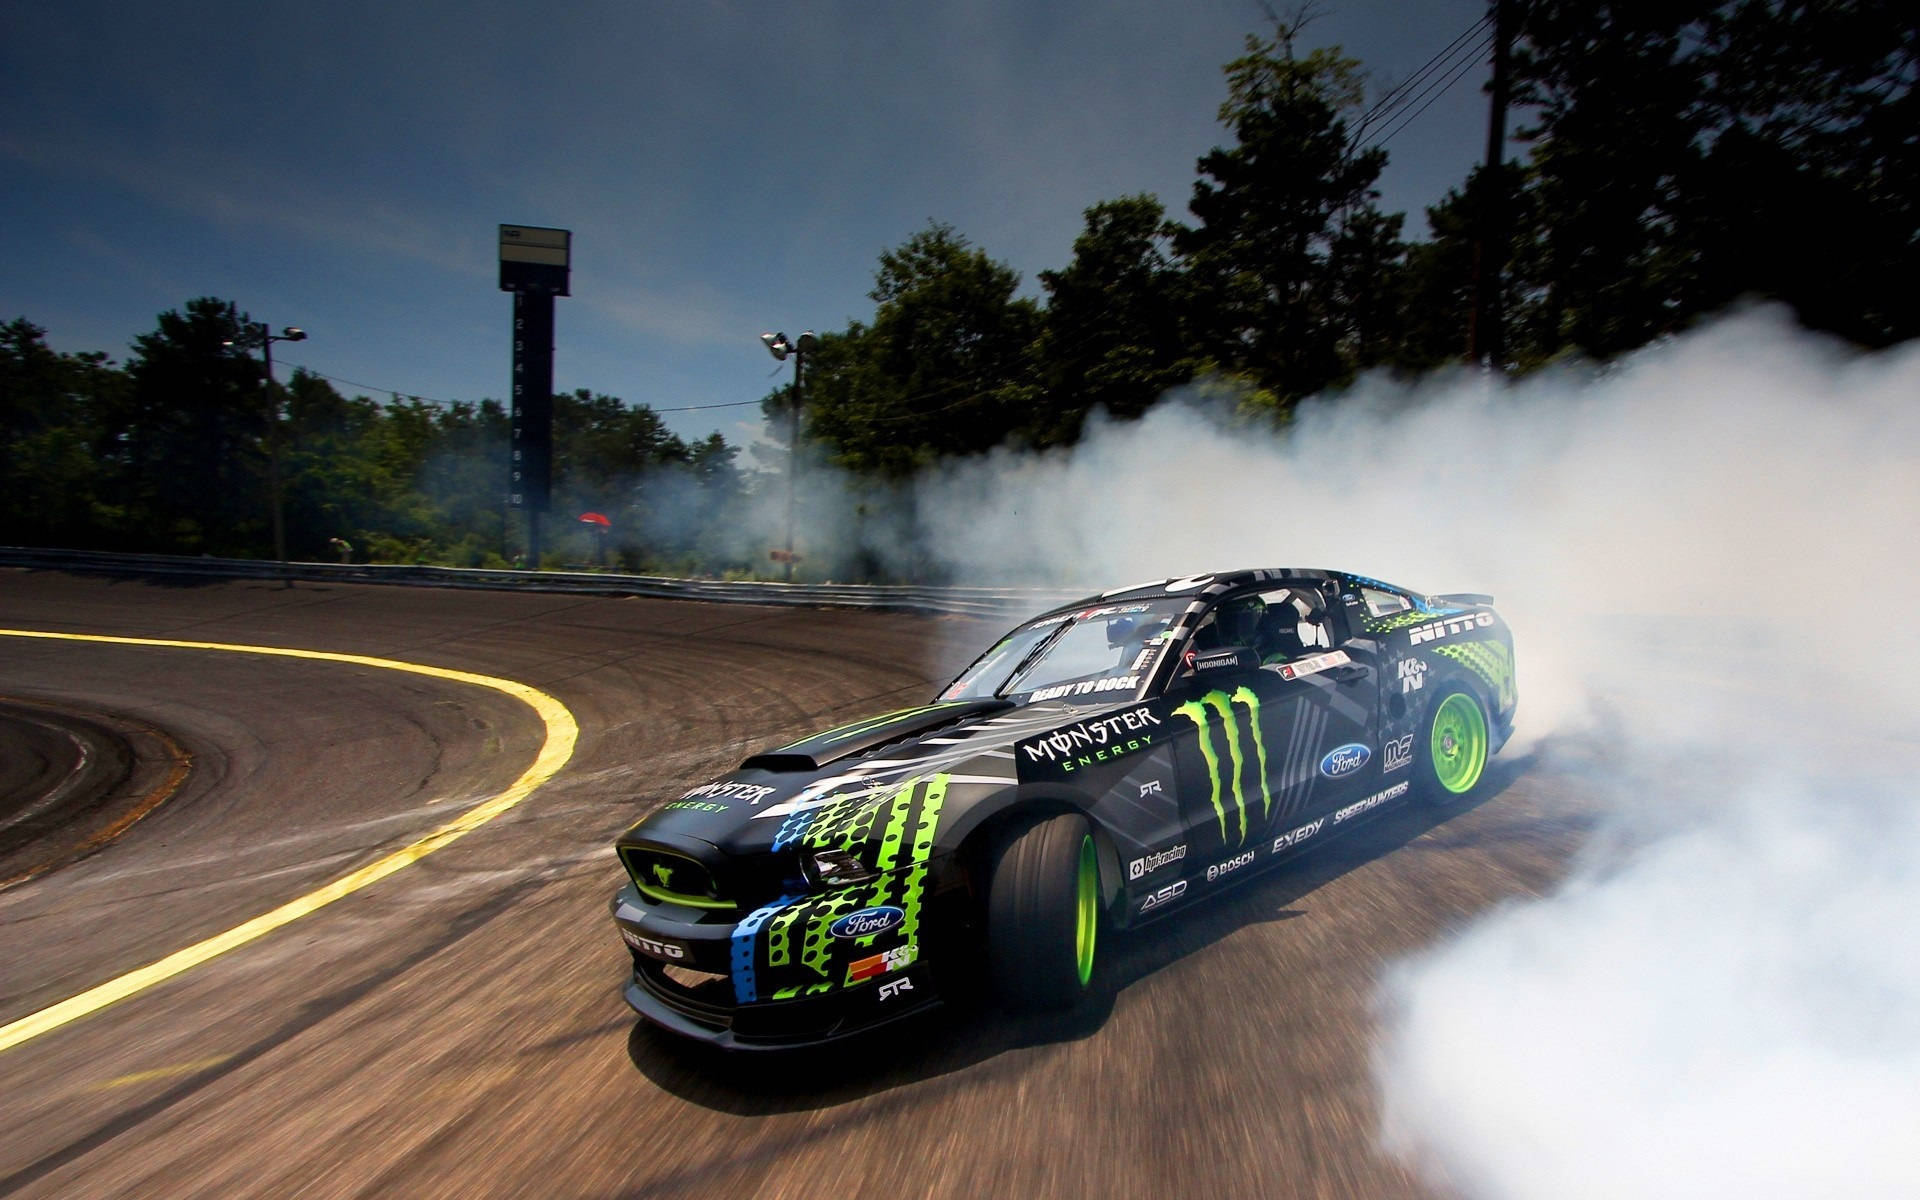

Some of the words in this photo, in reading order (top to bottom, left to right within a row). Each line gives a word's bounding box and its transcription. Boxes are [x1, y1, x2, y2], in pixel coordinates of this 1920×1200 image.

[515, 319, 524, 330] 2
[514, 429, 524, 440] 7
[514, 471, 523, 482] 9
[1408, 611, 1495, 646] NITTO
[1028, 684, 1076, 704] READY
[1076, 680, 1095, 698] TO
[1095, 675, 1142, 694] ROCK
[1022, 706, 1162, 762] MONSTER
[1062, 735, 1152, 772] ENERGY
[1331, 747, 1363, 776] Ford
[665, 801, 730, 814] ENERGY
[1271, 817, 1325, 855] EXEDY
[1218, 850, 1256, 876] BOSCH
[843, 908, 893, 936] Ford
[621, 927, 684, 959] NITTO
